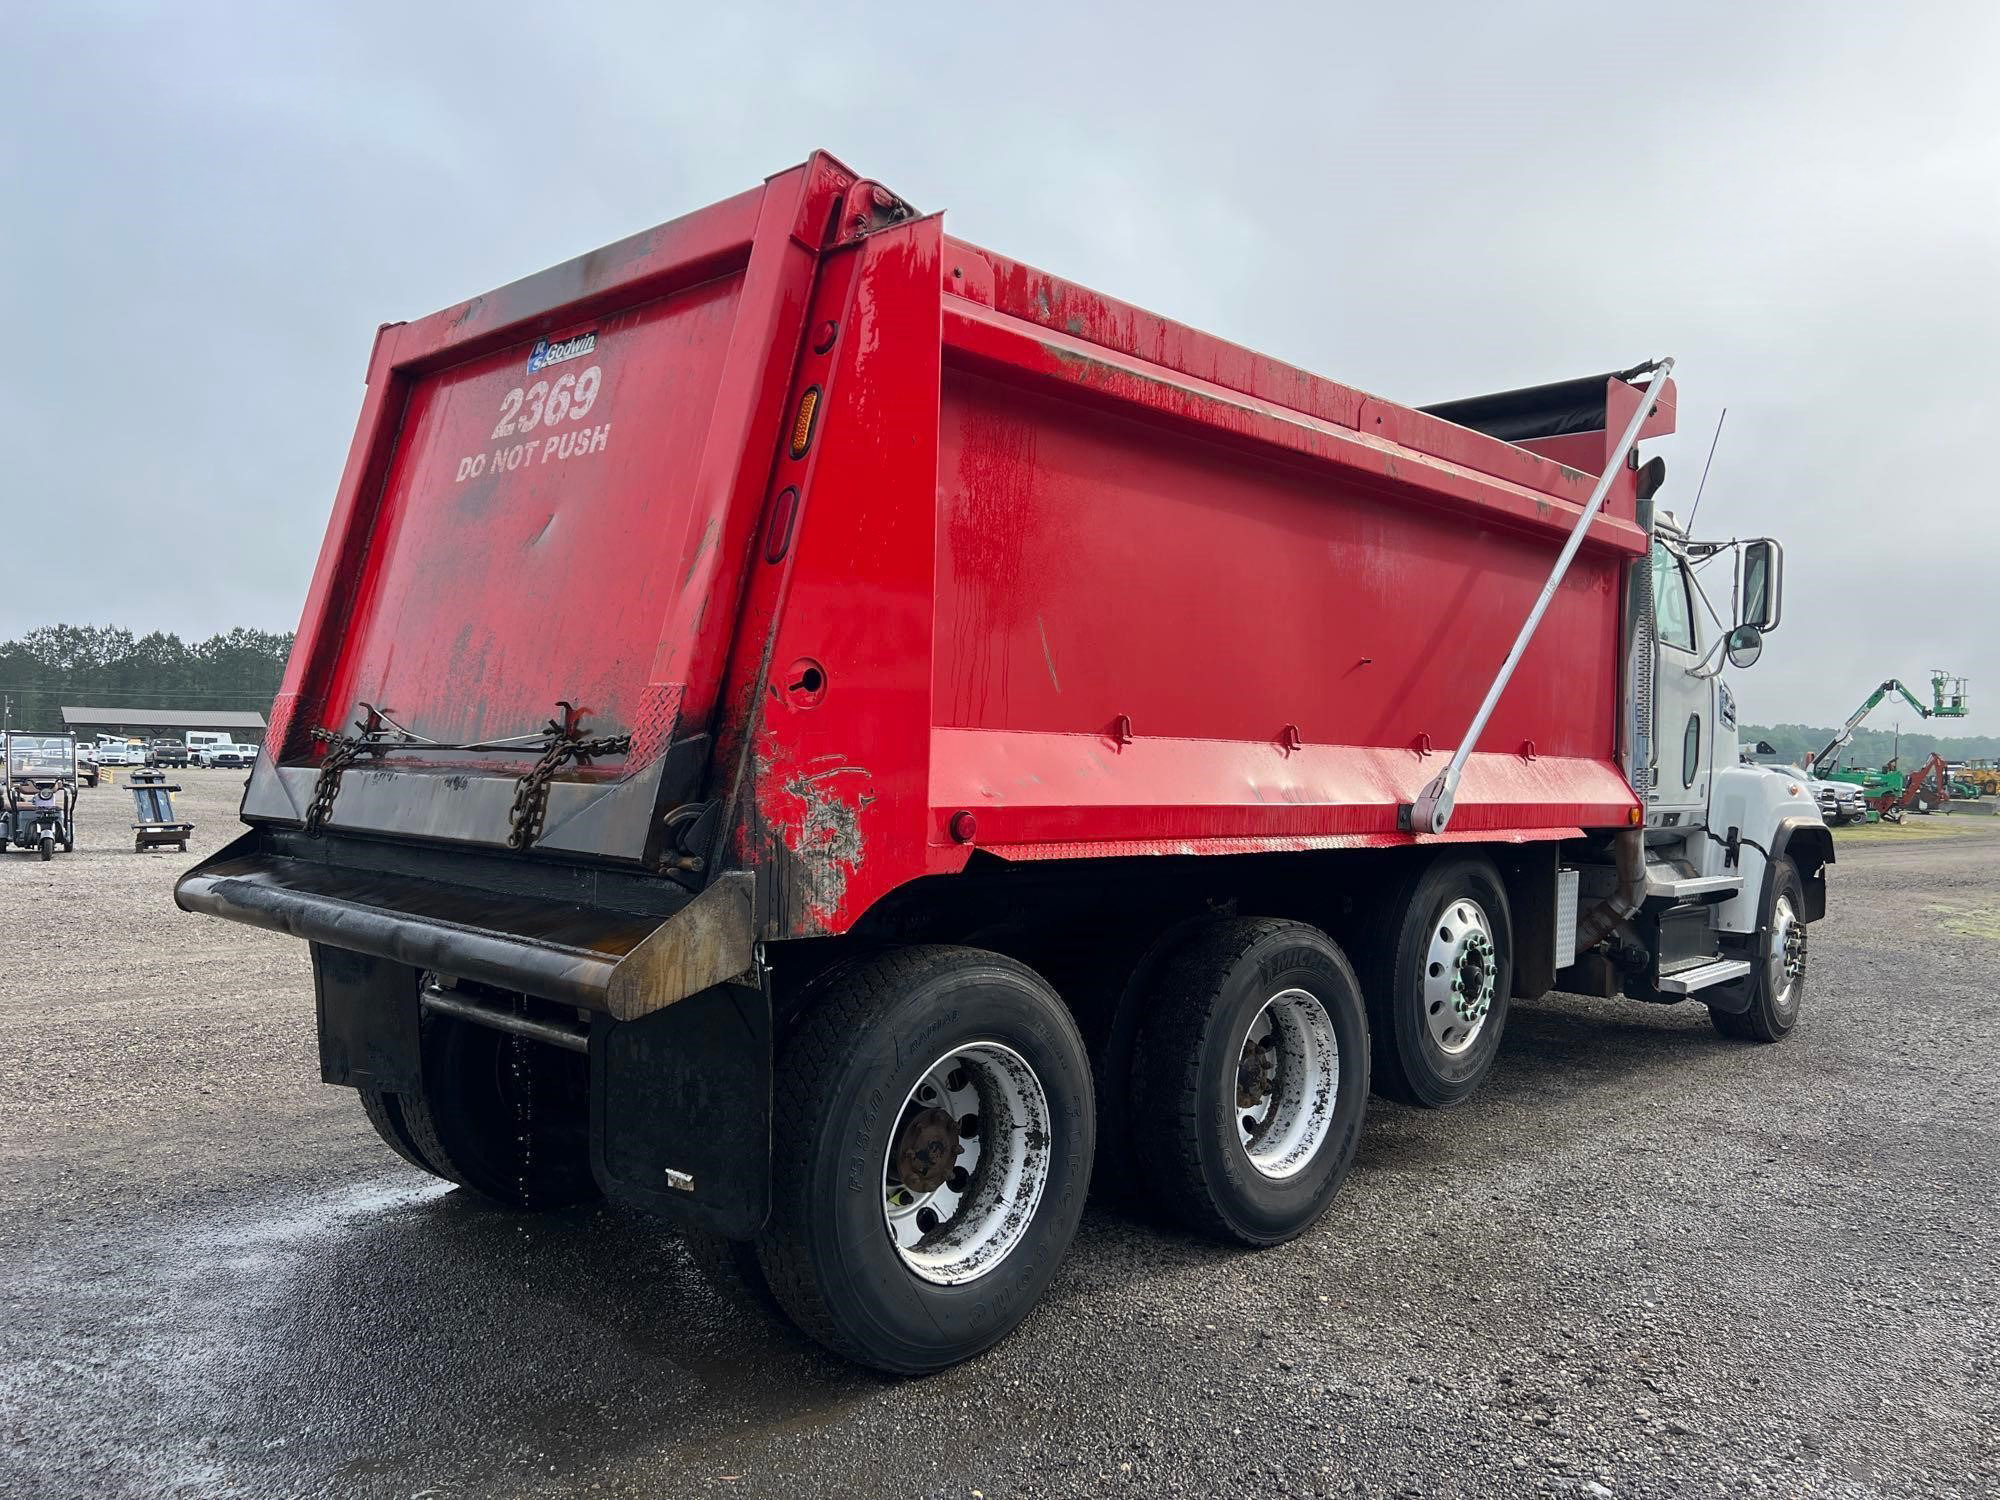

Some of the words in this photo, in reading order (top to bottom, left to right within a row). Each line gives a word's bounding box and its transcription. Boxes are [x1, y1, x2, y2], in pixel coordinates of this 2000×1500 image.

[547, 333, 595, 361] Godwin
[491, 365, 602, 440] 2369
[455, 453, 487, 483] DO
[490, 440, 540, 475] NOT
[541, 423, 612, 465] PUSH
